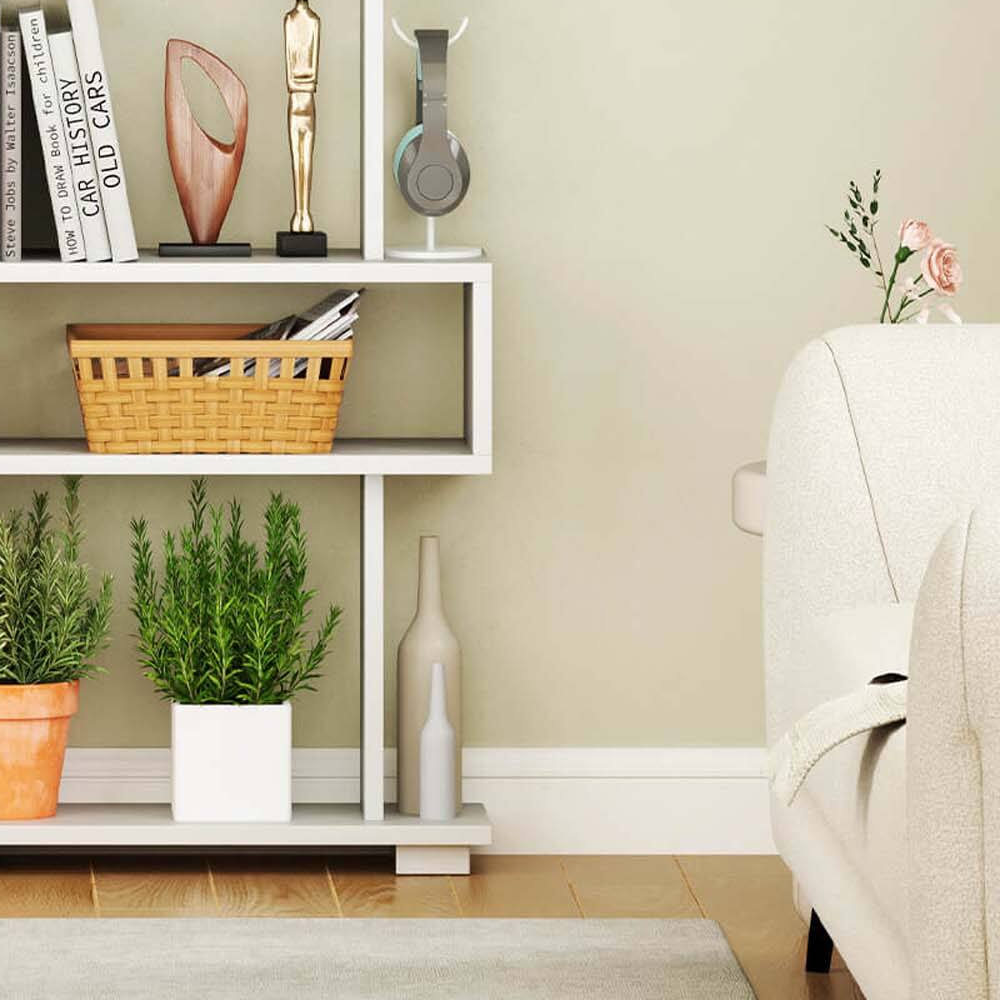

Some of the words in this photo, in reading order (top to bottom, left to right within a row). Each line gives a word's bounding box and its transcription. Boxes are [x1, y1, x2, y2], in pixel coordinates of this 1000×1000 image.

[6, 35, 16, 95] Isaacson
[29, 18, 48, 83] children
[41, 93, 53, 114] for
[85, 71, 110, 128] CARS
[6, 104, 16, 150] Walter
[60, 79, 91, 165] HISTORY
[48, 125, 60, 156] Book
[6, 159, 18, 173] by
[54, 165, 68, 198] DRAW
[98, 145, 120, 188] OLD
[6, 181, 16, 211] Jobs
[62, 206, 72, 220] TO
[79, 180, 99, 216] CAR
[6, 219, 16, 257] Steve
[65, 230, 78, 255] HOW
